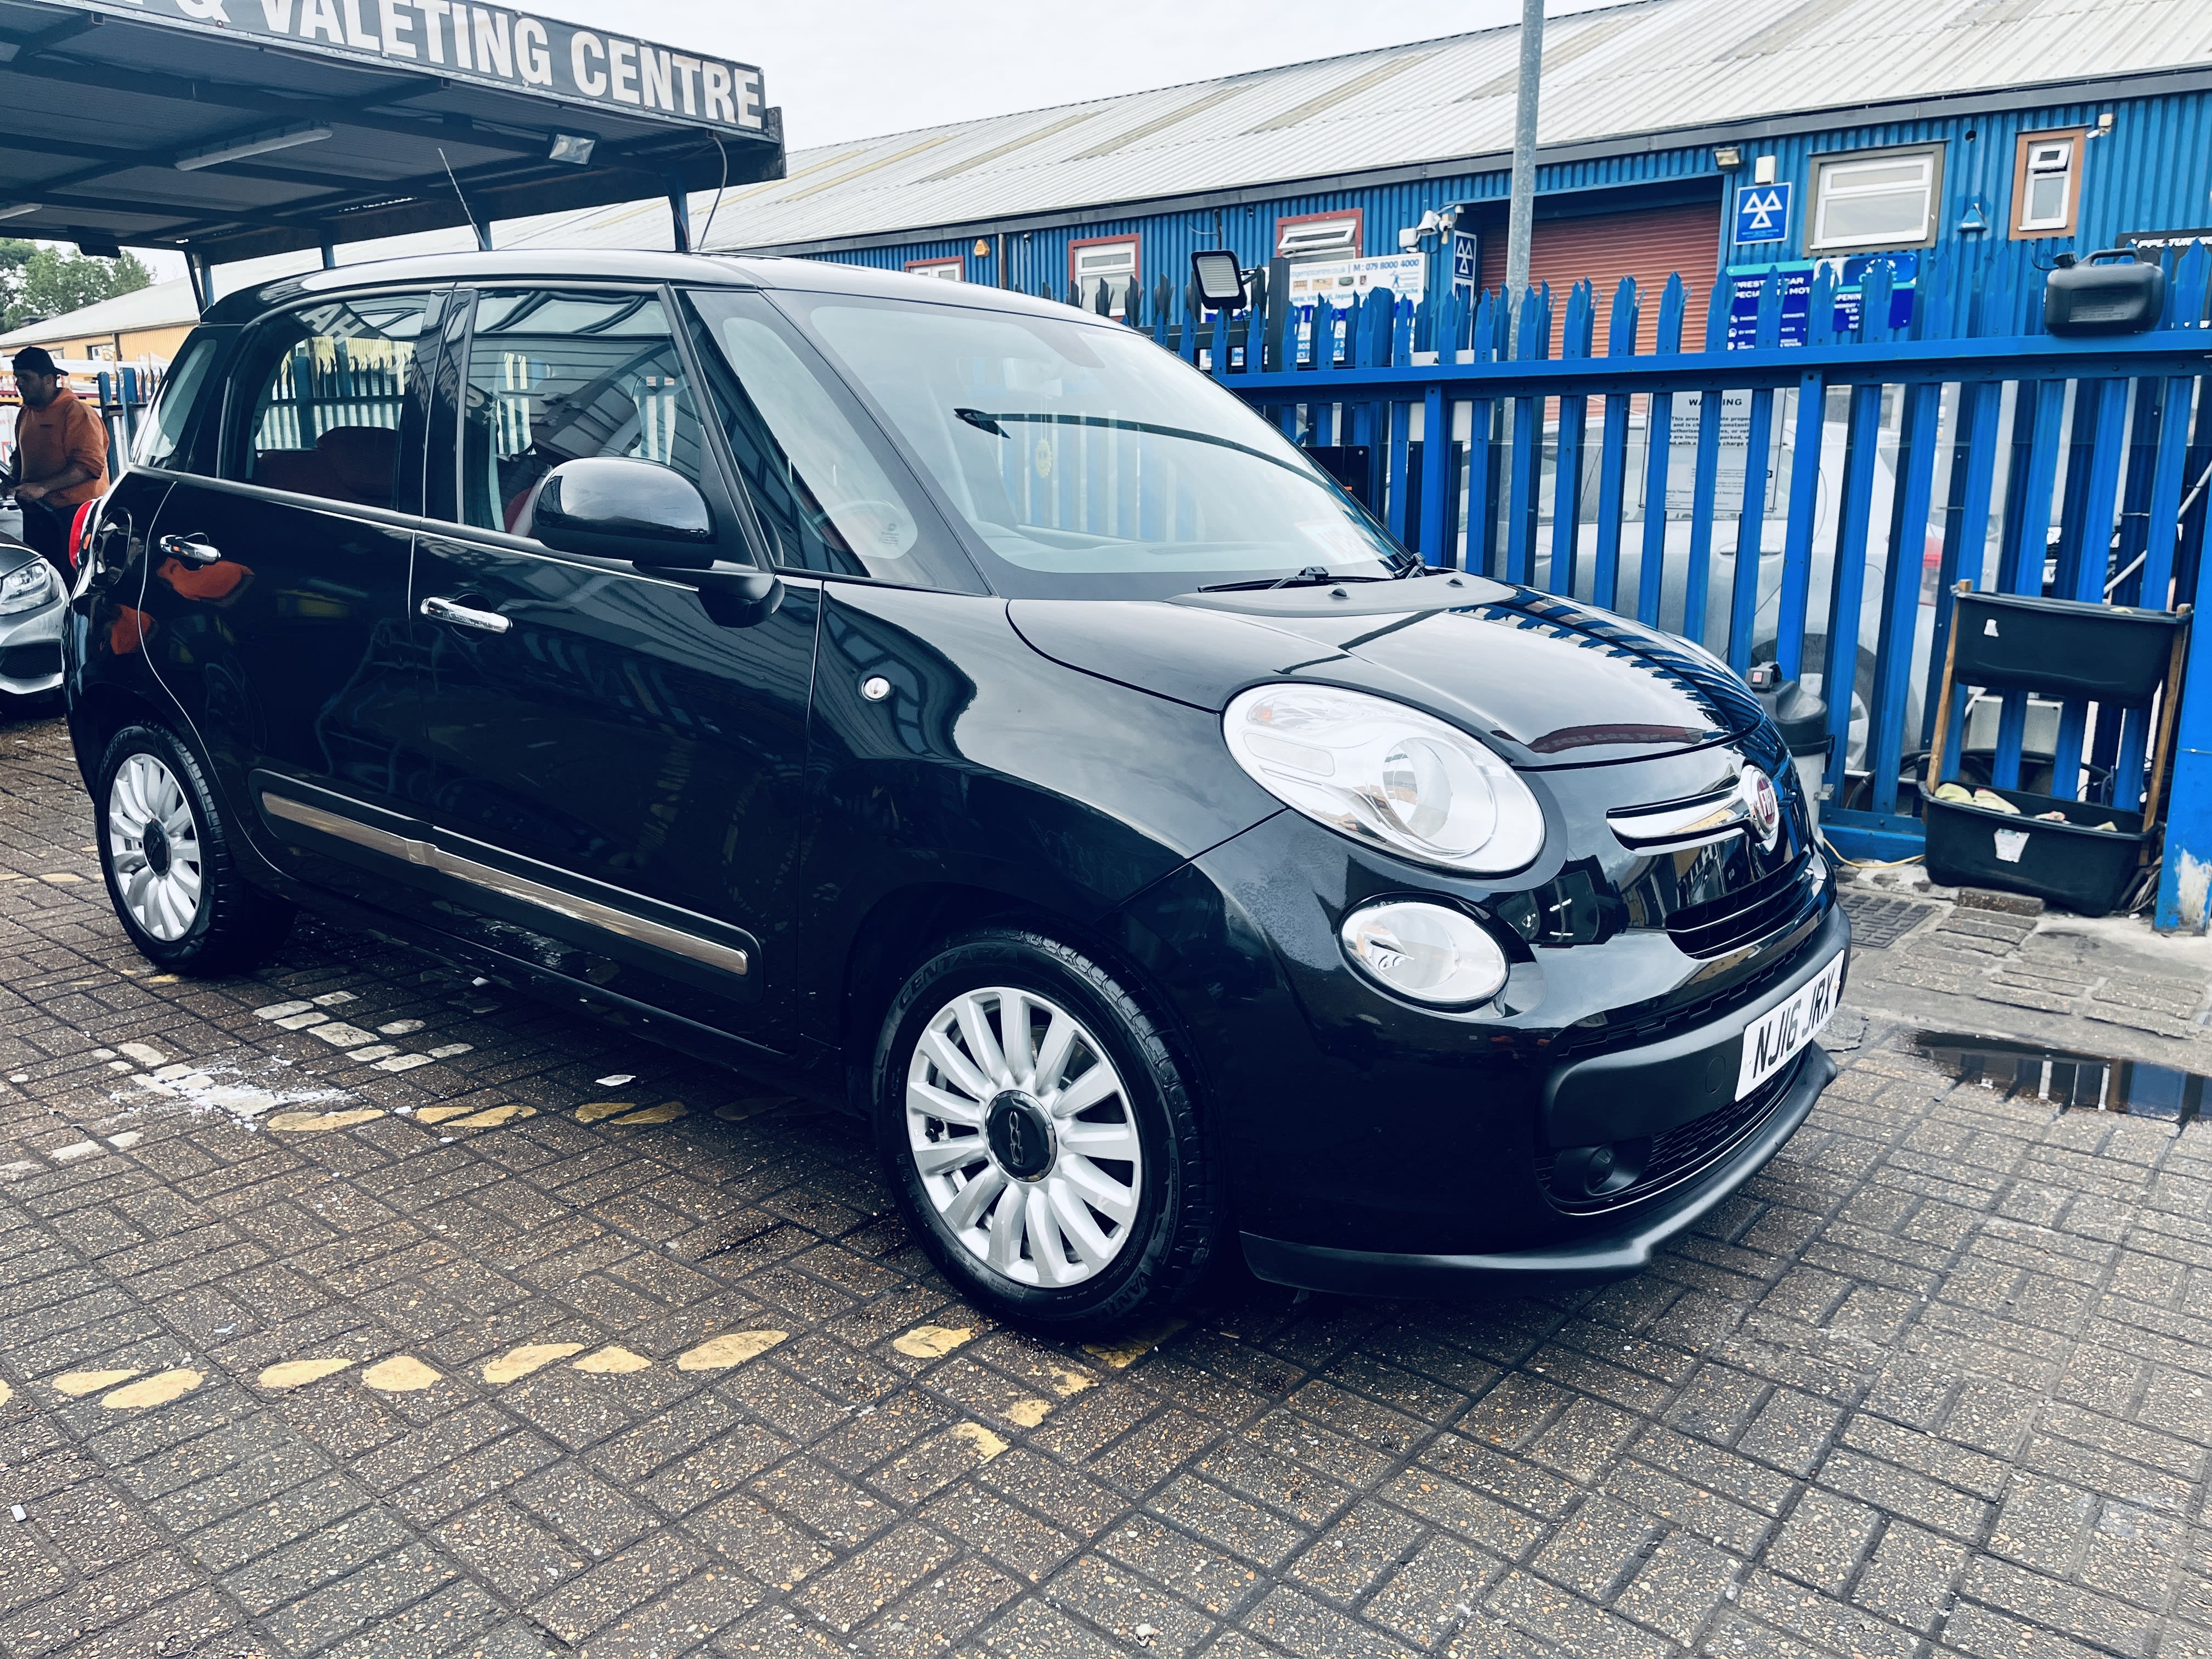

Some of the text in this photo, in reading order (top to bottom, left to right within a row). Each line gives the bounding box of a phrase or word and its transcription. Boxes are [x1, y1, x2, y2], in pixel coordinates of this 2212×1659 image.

[261, 0, 762, 129] VALETING CENTRE
[1753, 968, 1836, 1079] NJ16 JRX
